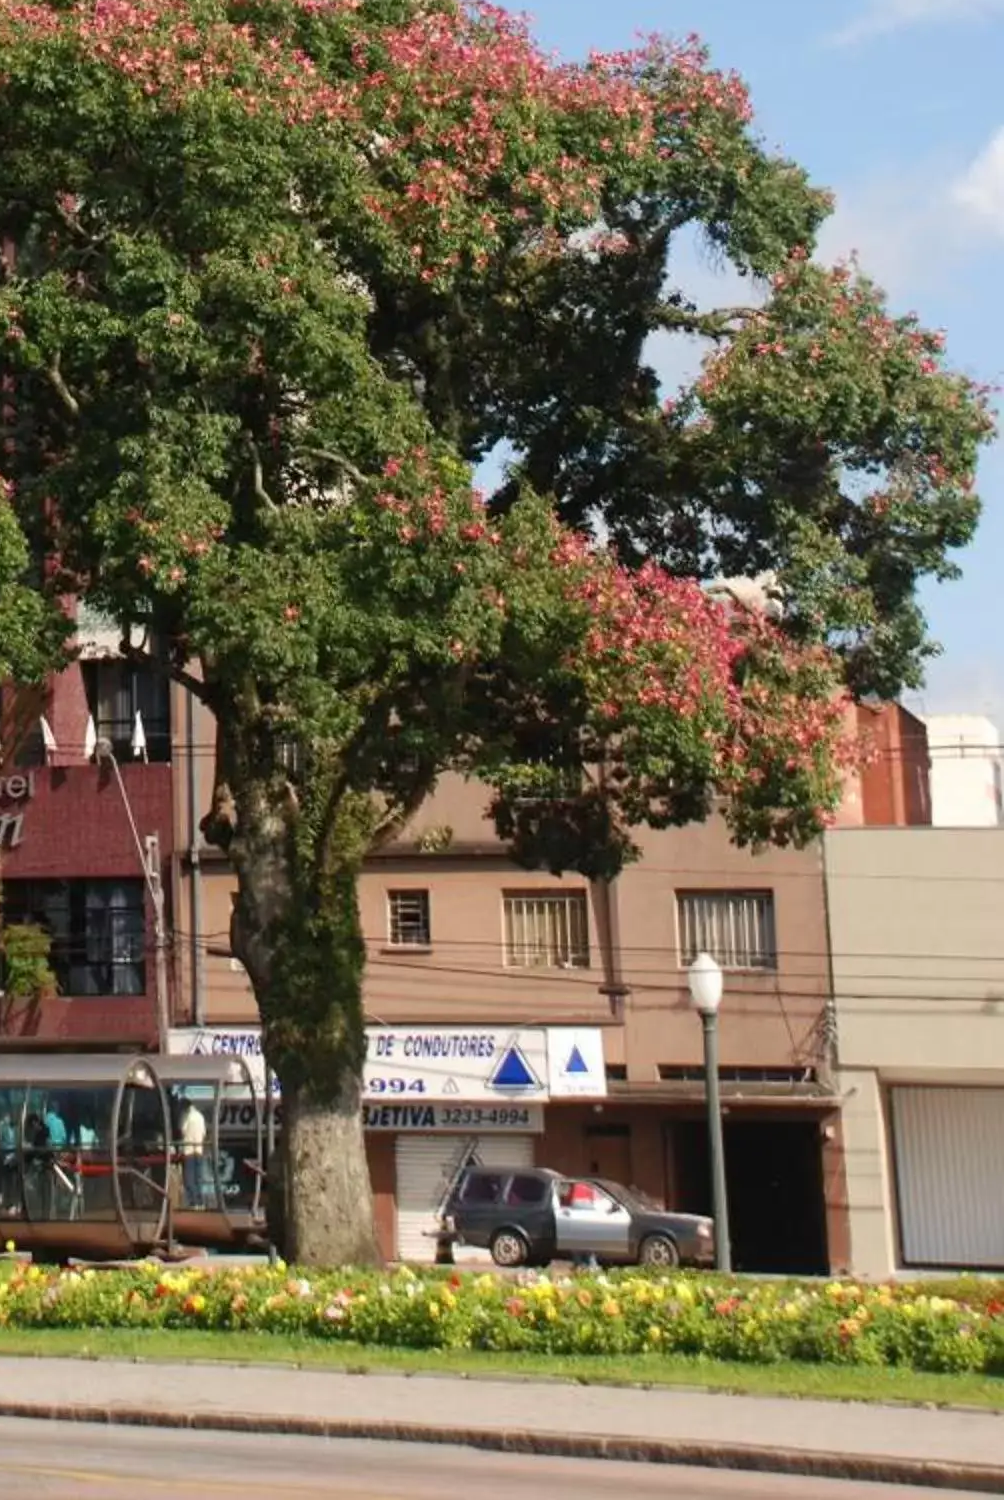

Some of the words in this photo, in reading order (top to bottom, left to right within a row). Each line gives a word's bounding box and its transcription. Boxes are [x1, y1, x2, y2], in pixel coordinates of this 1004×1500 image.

[376, 1035, 395, 1057] DE
[403, 1035, 496, 1057] CONDUTORES
[442, 1108, 529, 1124] 3233-4994
